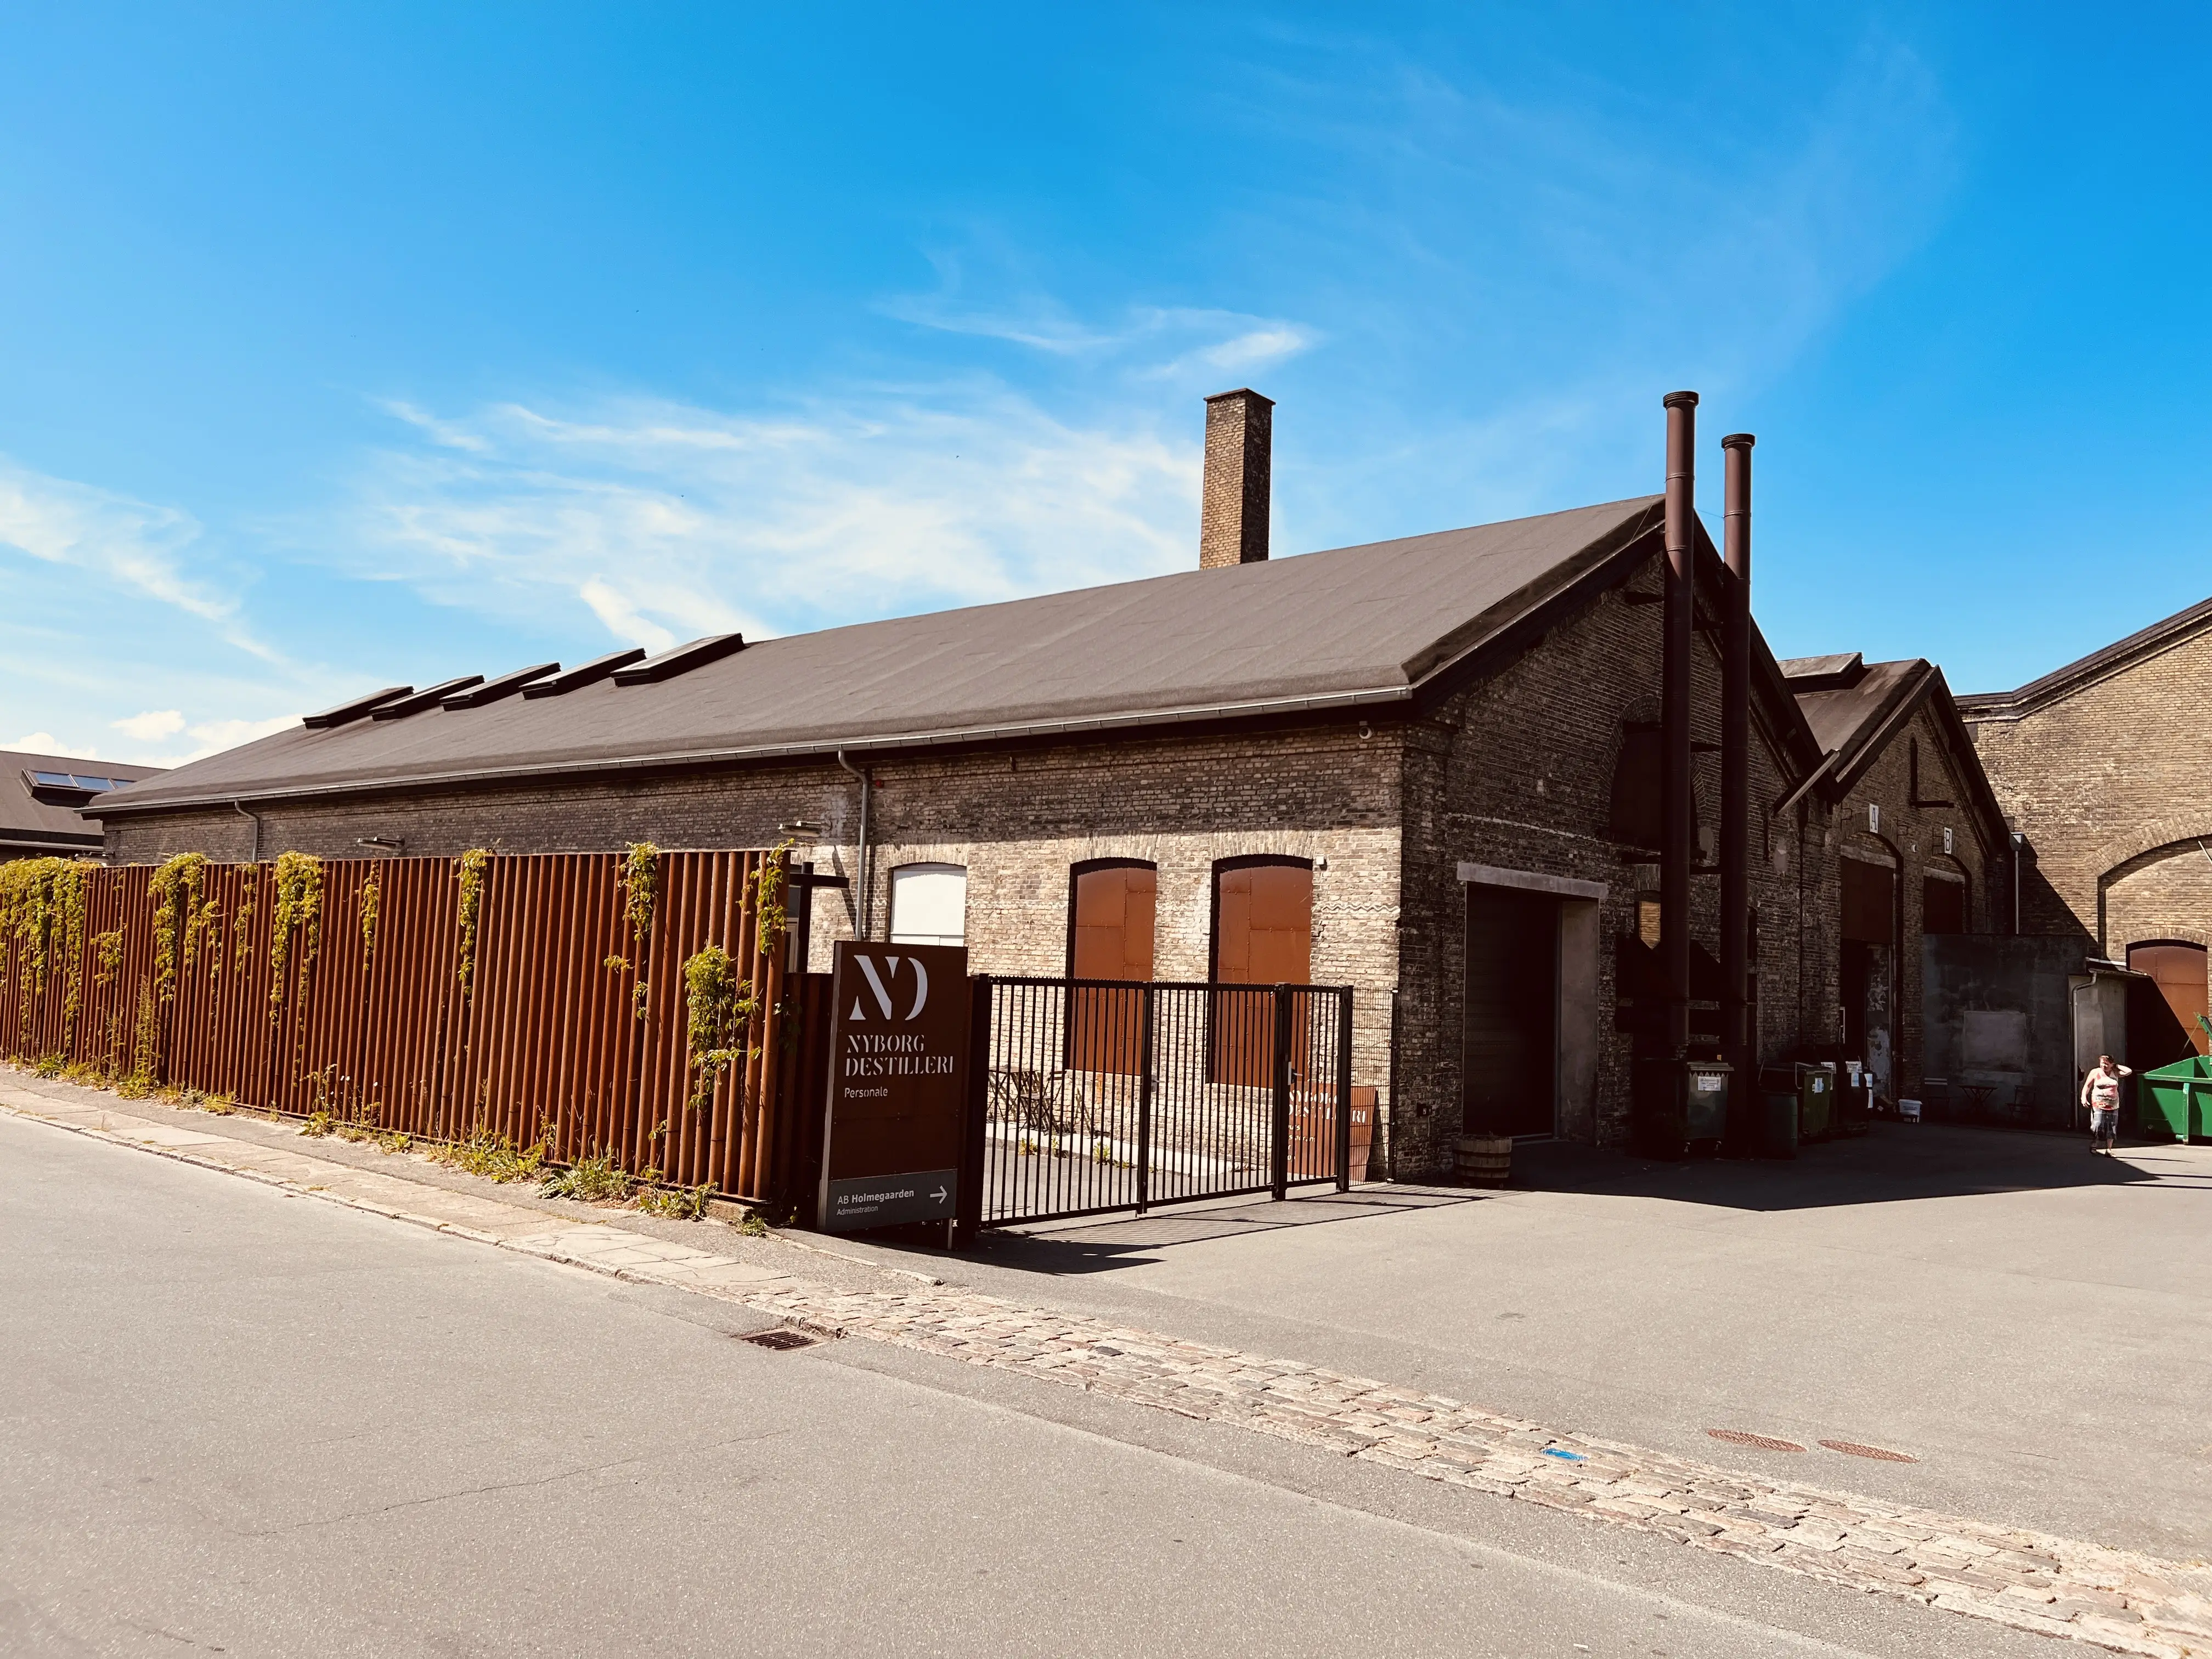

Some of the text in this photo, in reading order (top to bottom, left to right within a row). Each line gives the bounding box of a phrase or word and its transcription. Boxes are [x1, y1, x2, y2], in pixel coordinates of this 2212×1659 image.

[1871, 807, 1877, 830] A
[1945, 830, 1951, 851] B
[847, 1035, 924, 1053] NYBORG
[845, 1056, 953, 1076] DESTILLERI
[844, 1086, 888, 1098] Personale
[837, 1189, 914, 1205] AB Holmegaarden
[837, 1206, 878, 1216] Administration
